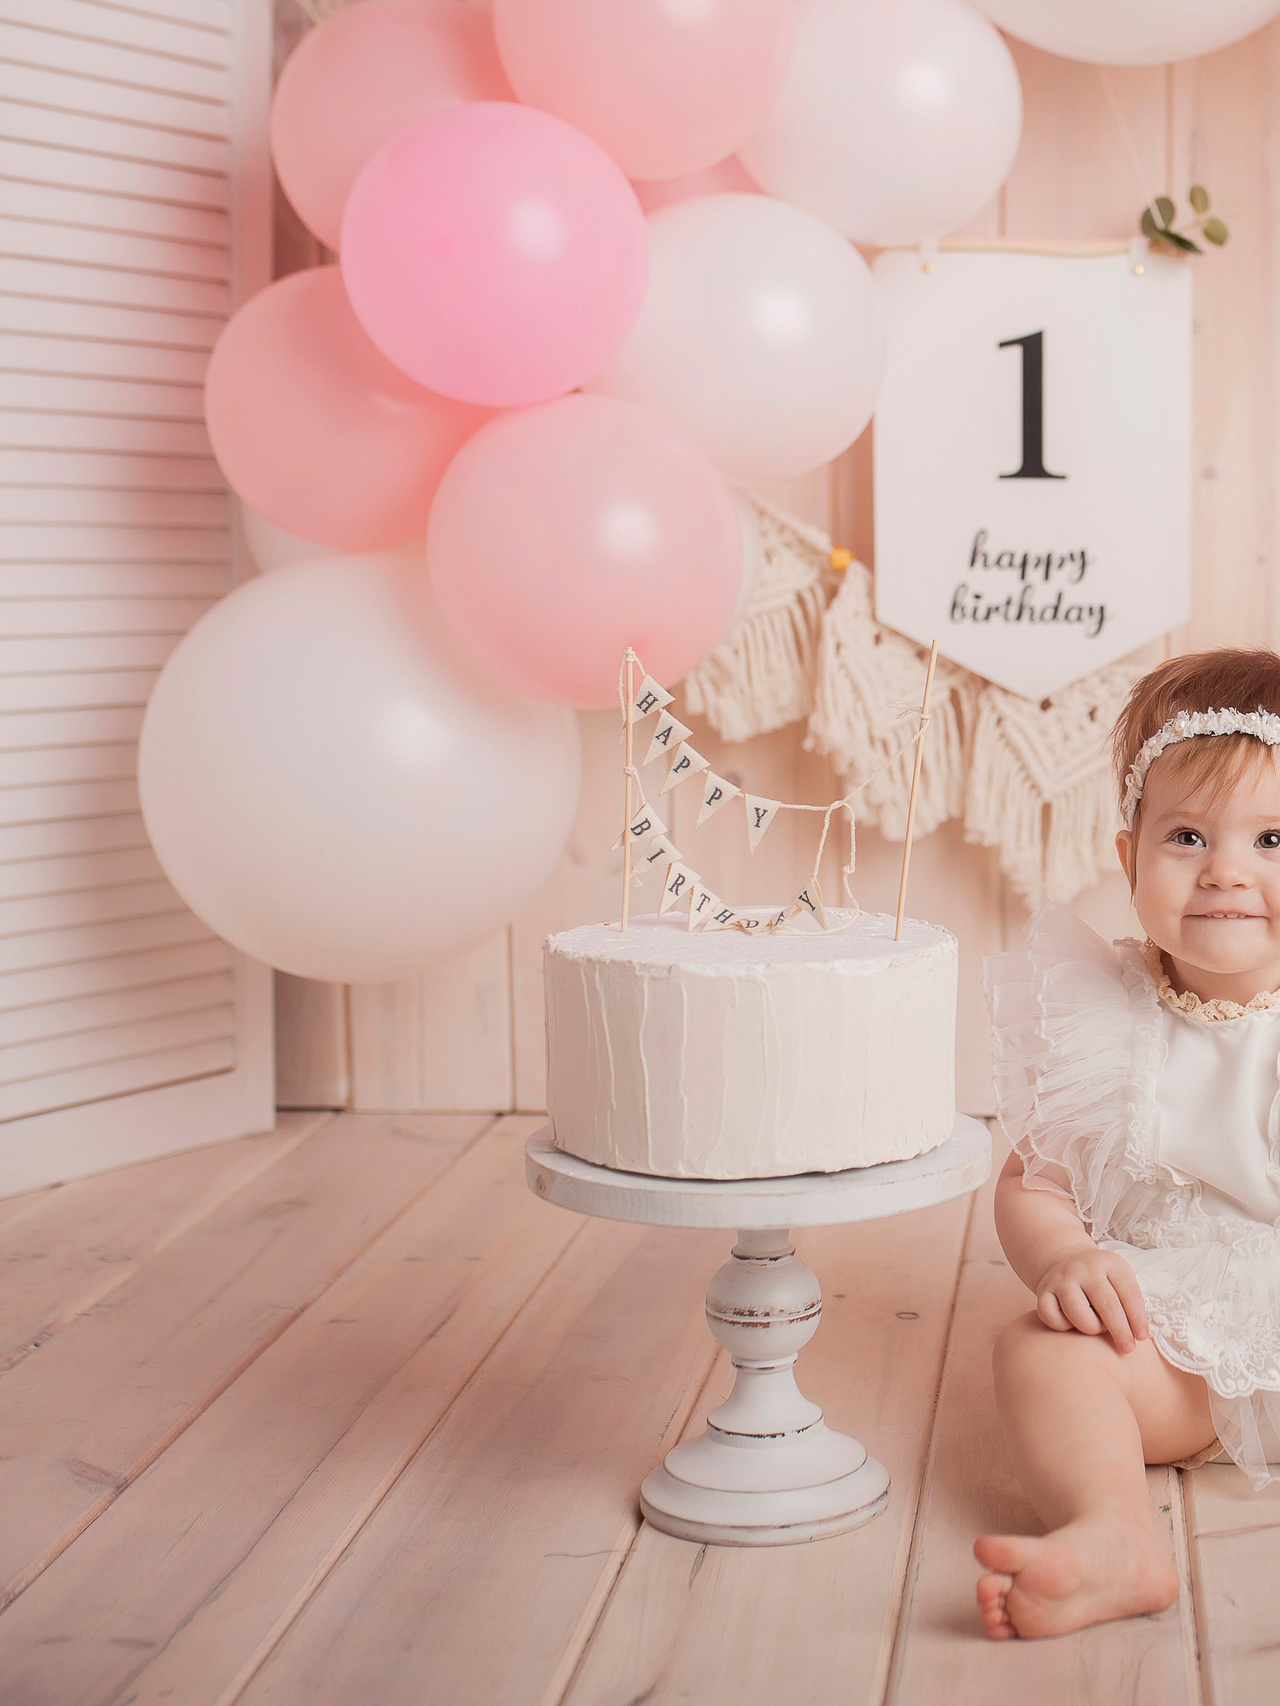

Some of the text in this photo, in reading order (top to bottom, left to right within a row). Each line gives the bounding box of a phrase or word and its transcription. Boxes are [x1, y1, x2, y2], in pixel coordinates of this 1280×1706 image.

[998, 330, 1067, 480] 1
[969, 528, 1092, 584] happy
[949, 583, 1112, 639] birthday
[635, 690, 769, 829] HAPPY
